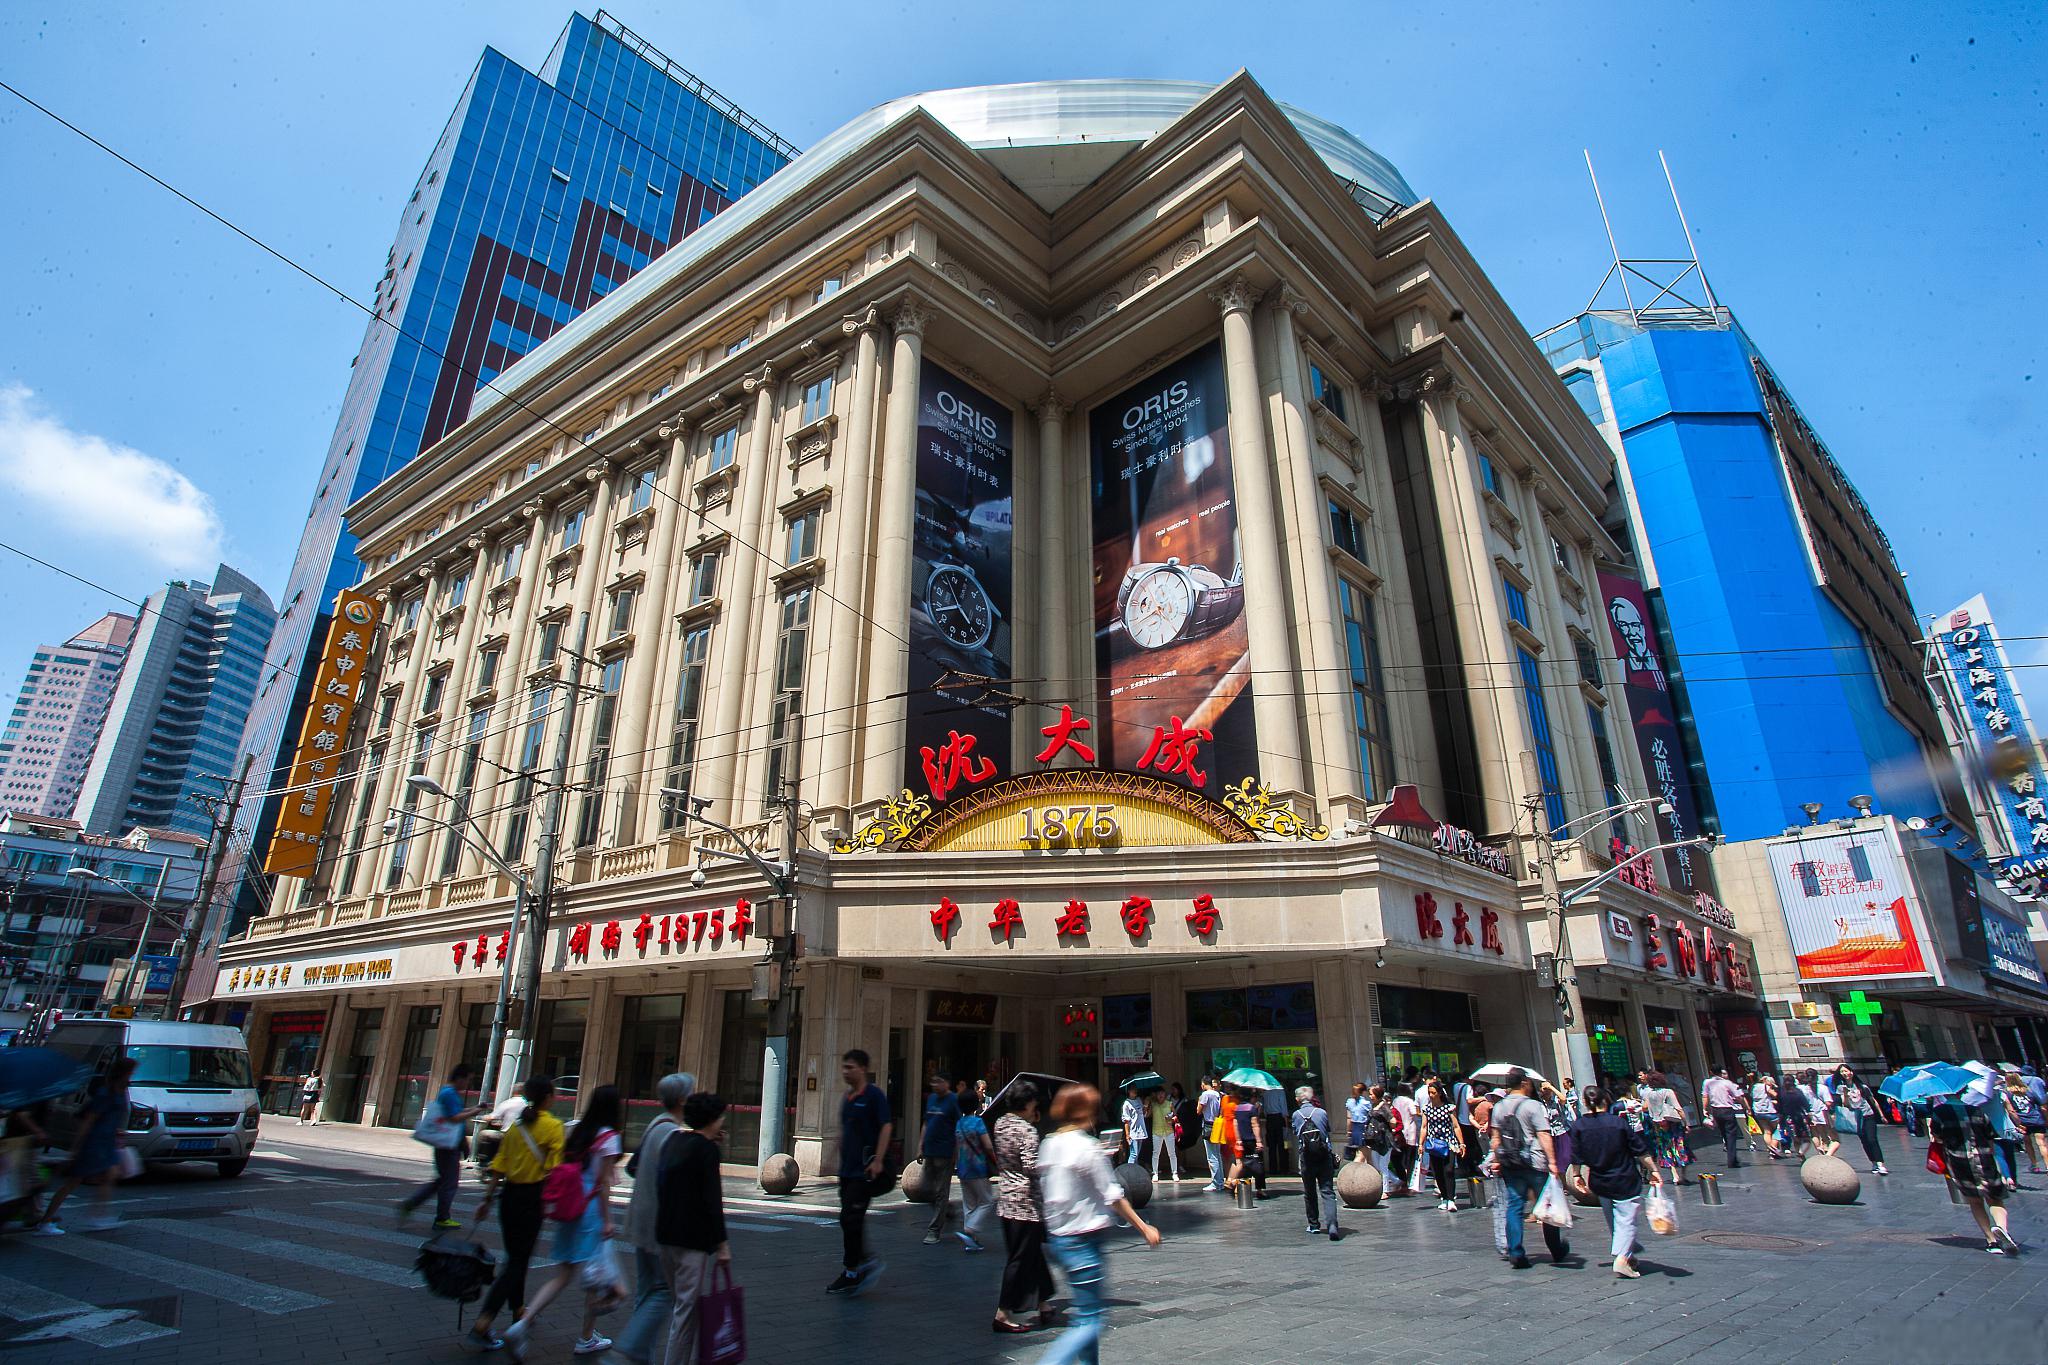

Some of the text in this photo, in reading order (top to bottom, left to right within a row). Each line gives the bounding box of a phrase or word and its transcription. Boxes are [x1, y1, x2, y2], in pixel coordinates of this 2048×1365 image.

[936, 390, 997, 440] ORIS
[1112, 396, 1201, 449] Swiss Made Watches
[1122, 380, 1188, 430] ORIS
[925, 403, 1007, 457] Swiss Made Watches
[936, 423, 995, 461] Since 1904
[1125, 413, 1189, 453] Since 1904
[930, 441, 999, 488] 瑞士豪利时表
[1120, 435, 1194, 481] 瑞士豪利时表
[1155, 527, 1166, 538] real
[1166, 518, 1189, 532] watches
[1198, 507, 1209, 518] real
[1210, 499, 1231, 514] people
[311, 629, 363, 752] 春申江賓館
[920, 703, 1213, 800] 沈大成
[1966, 647, 2048, 847] 上海市第一药商店
[1020, 804, 1119, 841] 1875
[1789, 858, 1853, 880] 有效避孕
[929, 894, 1220, 941] 中华老字号
[1414, 892, 1504, 955] 沈大成
[935, 1000, 987, 1019] 沈大成
